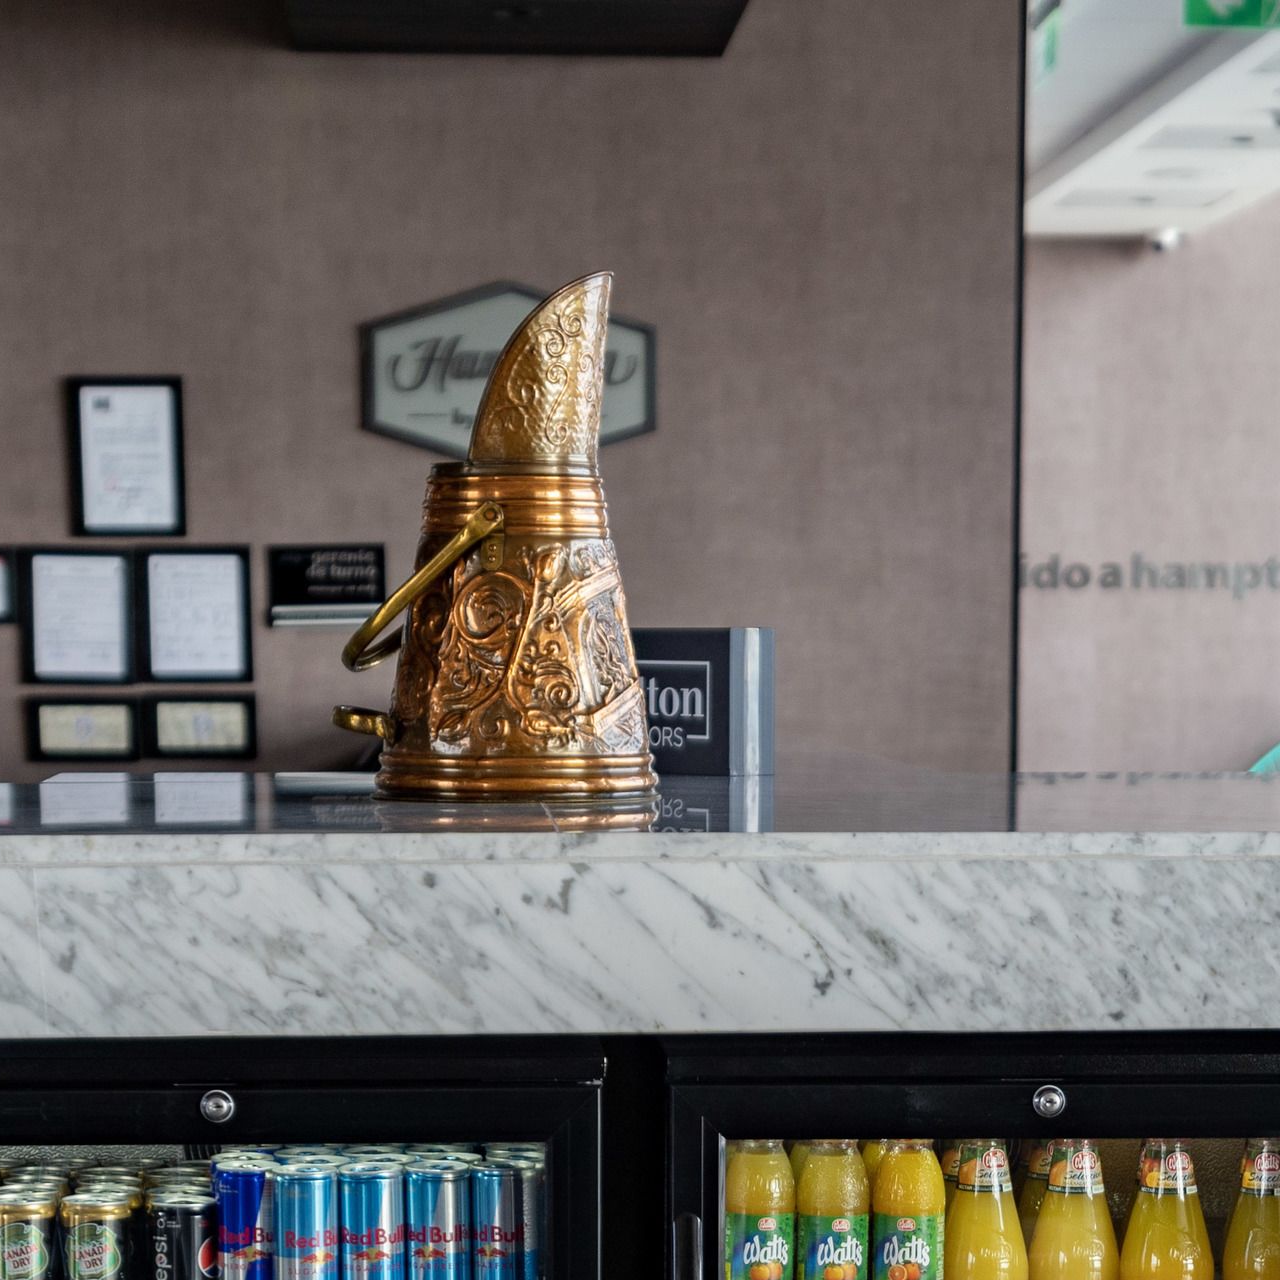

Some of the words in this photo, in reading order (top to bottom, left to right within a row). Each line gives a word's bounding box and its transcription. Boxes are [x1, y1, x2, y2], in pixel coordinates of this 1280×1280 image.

[1099, 562, 1122, 589] a
[285, 1230, 320, 1248] Red
[341, 1226, 372, 1245] Red
[375, 1224, 405, 1245] Bull
[407, 1226, 426, 1243] ed
[430, 1224, 462, 1243] Bull
[491, 1223, 524, 1243] Bull
[12, 1255, 32, 1269] DRY
